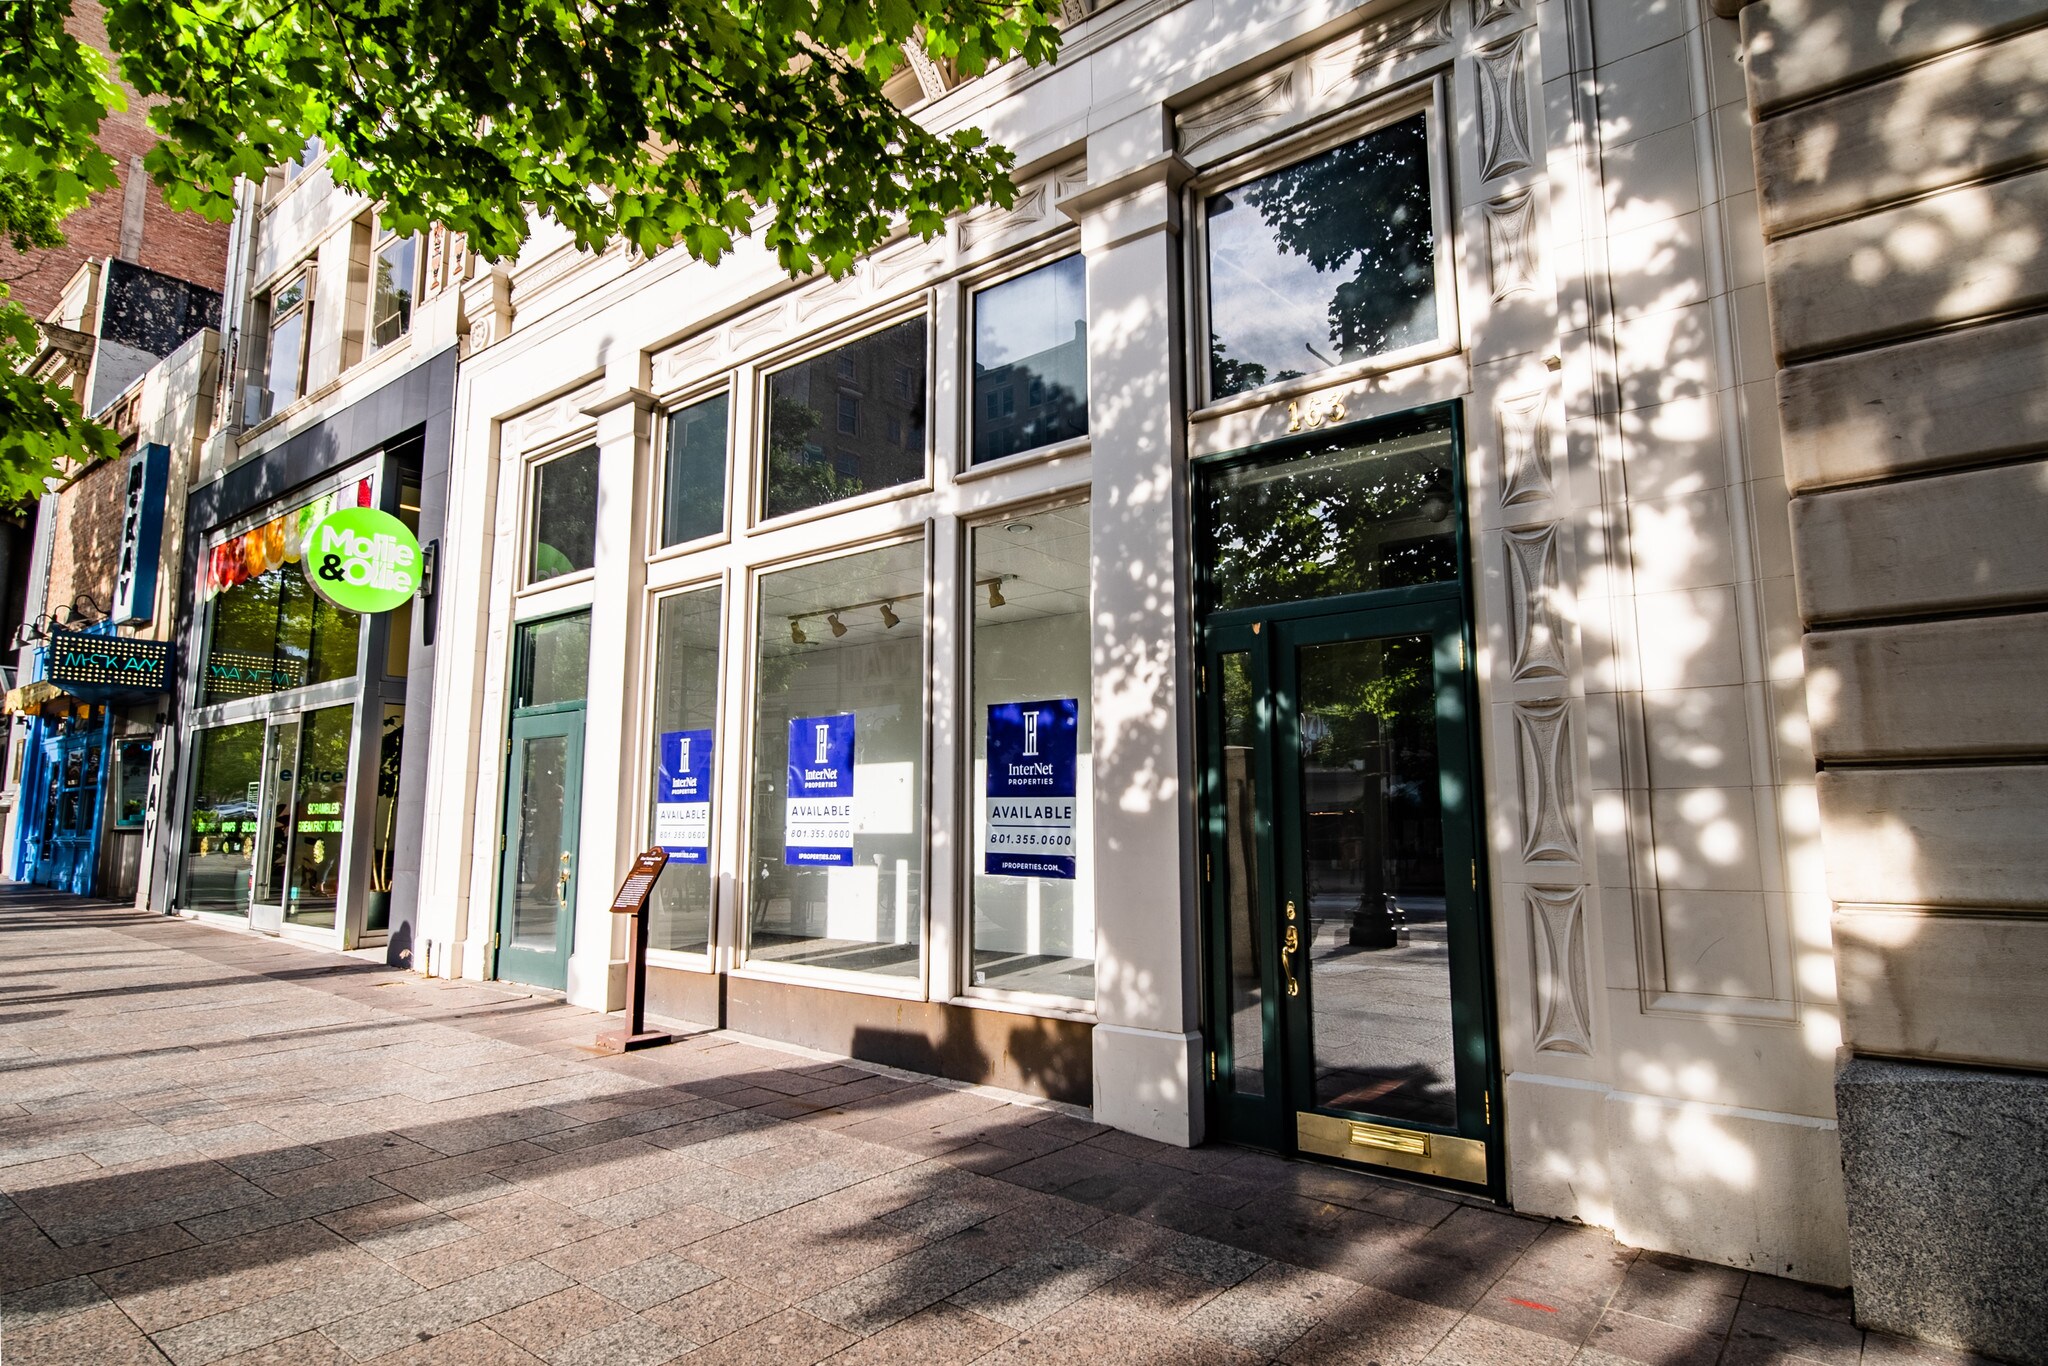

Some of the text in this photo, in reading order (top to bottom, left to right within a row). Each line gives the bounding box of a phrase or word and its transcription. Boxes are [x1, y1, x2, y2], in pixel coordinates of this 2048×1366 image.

[1288, 392, 1346, 432] 163
[321, 525, 414, 567] Mollie
[805, 768, 838, 780] InterNet
[1008, 762, 1054, 776] InterNet
[672, 777, 698, 788] InterNet
[307, 803, 340, 815] SCRAMBLES
[660, 809, 706, 820] AVAILABLE
[791, 805, 850, 816] AVAILABLE
[992, 806, 1072, 819] AVAILABLE
[297, 820, 344, 832] BREAKFAST BOWL
[659, 831, 706, 839] 801.355.0600
[790, 829, 850, 839] 801.355.0600
[990, 834, 1071, 846] 801.355.0600
[798, 853, 842, 861] IPROPERTIES.COM
[1002, 862, 1058, 871] IPROPERTIES.COM
